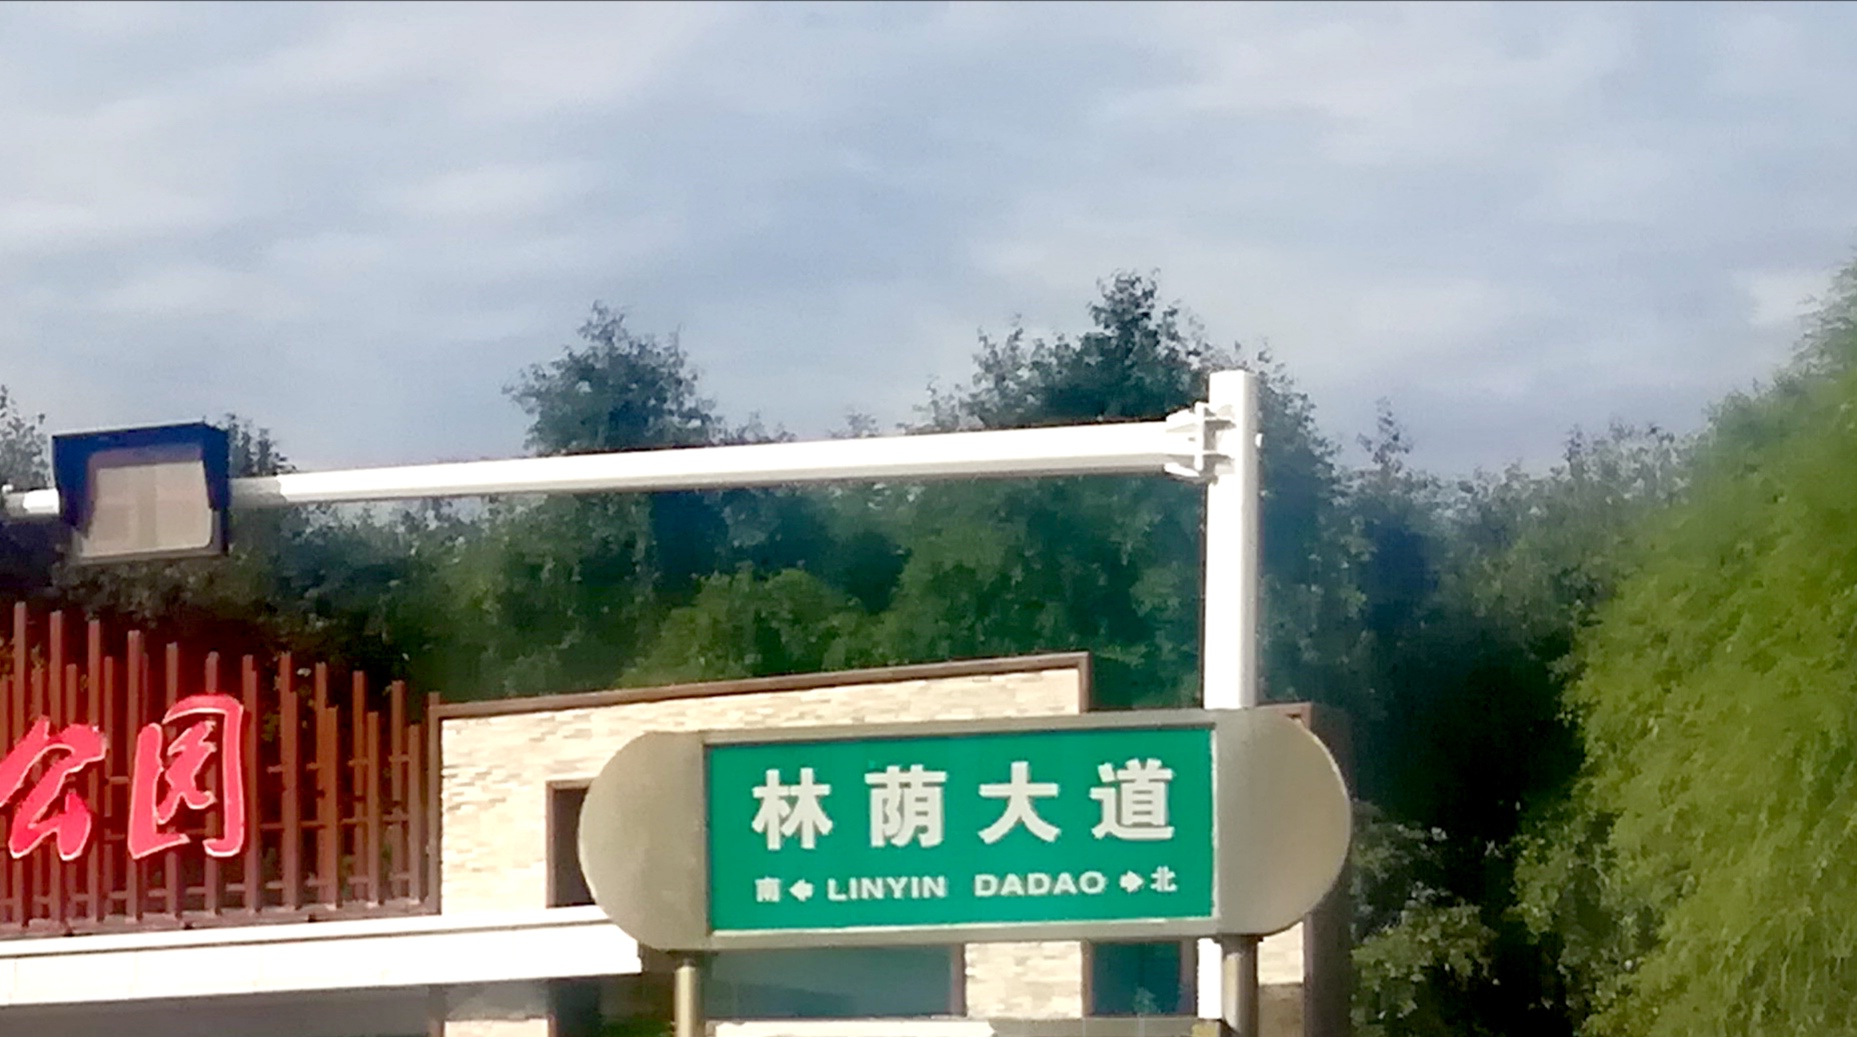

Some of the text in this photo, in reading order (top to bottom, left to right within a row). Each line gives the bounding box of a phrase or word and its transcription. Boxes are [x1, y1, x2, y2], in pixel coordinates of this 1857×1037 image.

[751, 758, 1175, 850] 林荫大道
[755, 877, 780, 902] 南
[826, 871, 1107, 901] LINYIN DADAO
[1150, 866, 1177, 893] 北
